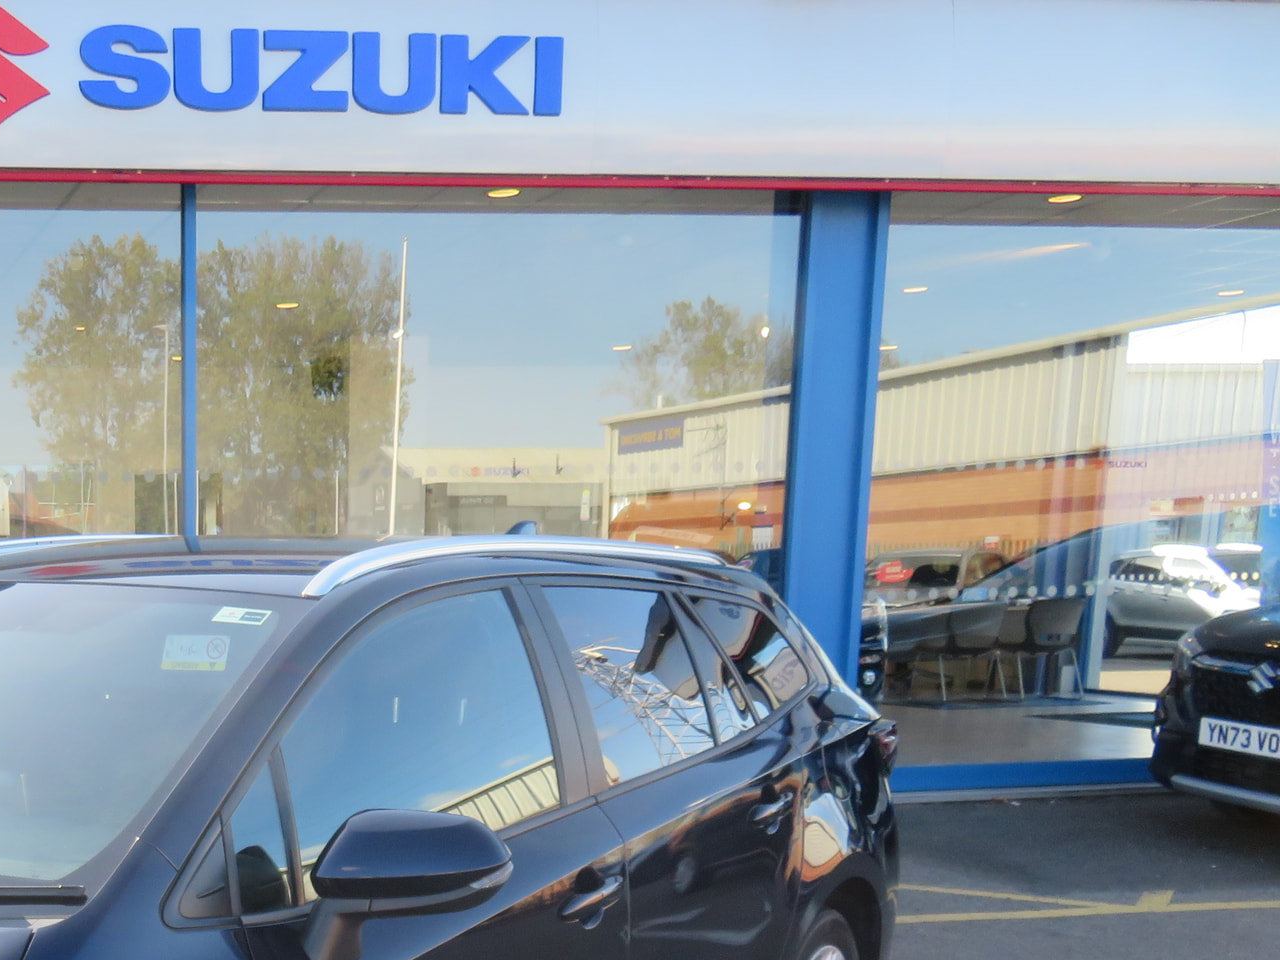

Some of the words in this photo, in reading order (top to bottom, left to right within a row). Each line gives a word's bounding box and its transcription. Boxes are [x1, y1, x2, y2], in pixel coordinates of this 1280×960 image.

[78, 24, 564, 118] SUZUKI
[1108, 460, 1148, 469] SUZUKI
[1207, 722, 1252, 749] YN73
